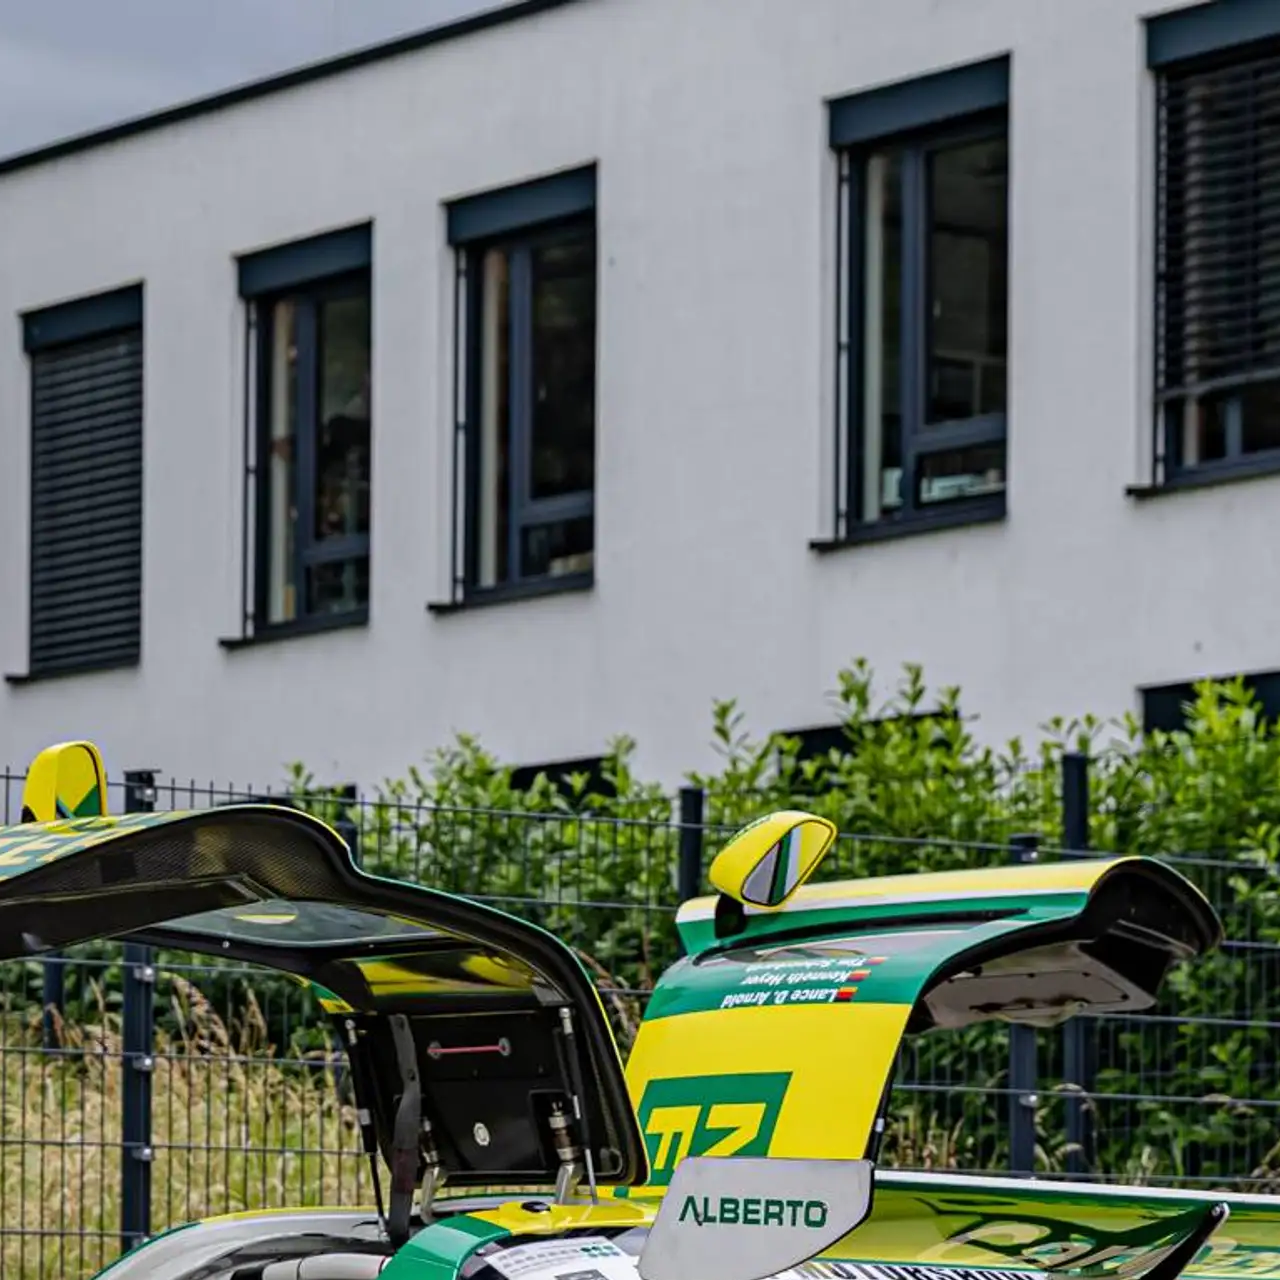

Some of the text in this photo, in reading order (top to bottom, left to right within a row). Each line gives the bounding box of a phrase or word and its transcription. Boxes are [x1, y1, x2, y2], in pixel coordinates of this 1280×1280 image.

[720, 991, 770, 1009] Arnold
[790, 987, 838, 1003] Lance
[678, 1195, 829, 1228] ALBERTO
